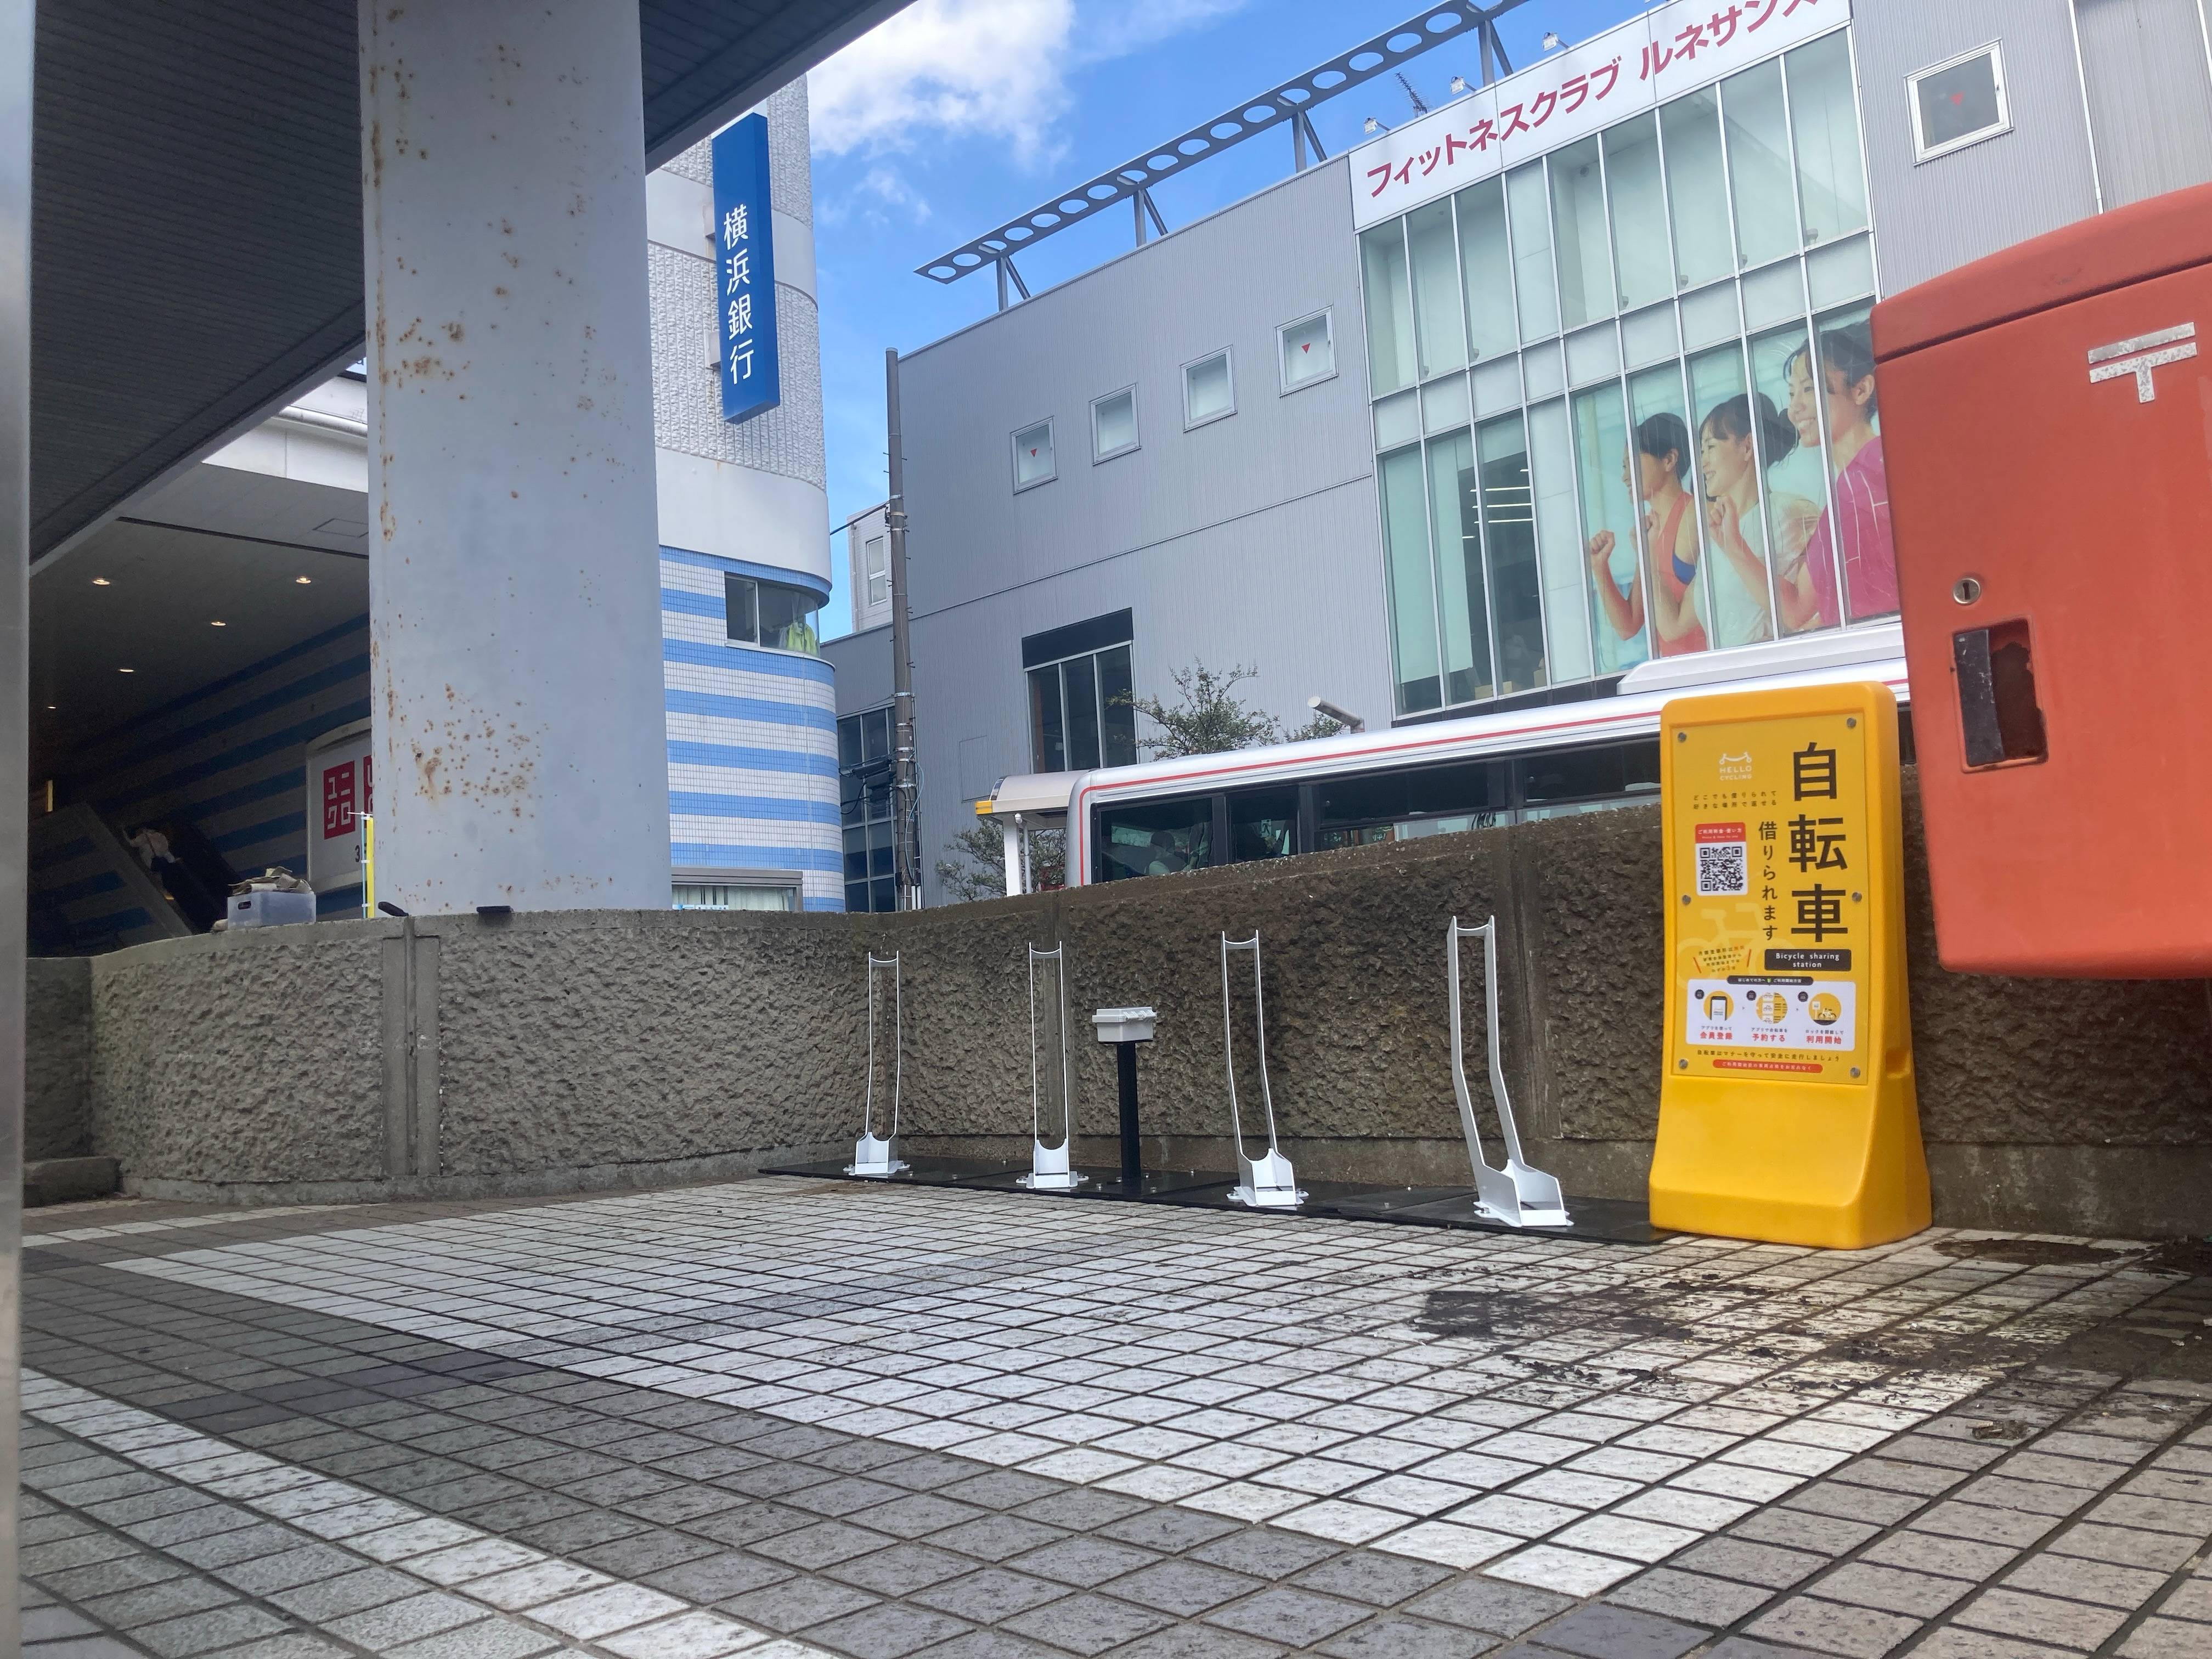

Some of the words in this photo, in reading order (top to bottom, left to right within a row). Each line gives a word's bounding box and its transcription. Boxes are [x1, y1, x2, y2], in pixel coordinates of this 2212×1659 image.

[1367, 55, 1622, 198] フィットネスクラブ
[724, 204, 754, 385] 横浜銀行
[1719, 765, 1752, 774] HELLO
[1787, 742, 1848, 943] 自転車
[1758, 821, 1778, 941] 借りられます
[1775, 952, 1805, 961] Bicycle
[1809, 952, 1839, 961] sharing
[1700, 1031, 1733, 1040] 会員登録
[1752, 1033, 1786, 1042] 予約する
[1806, 1036, 1842, 1045] 利用開始
